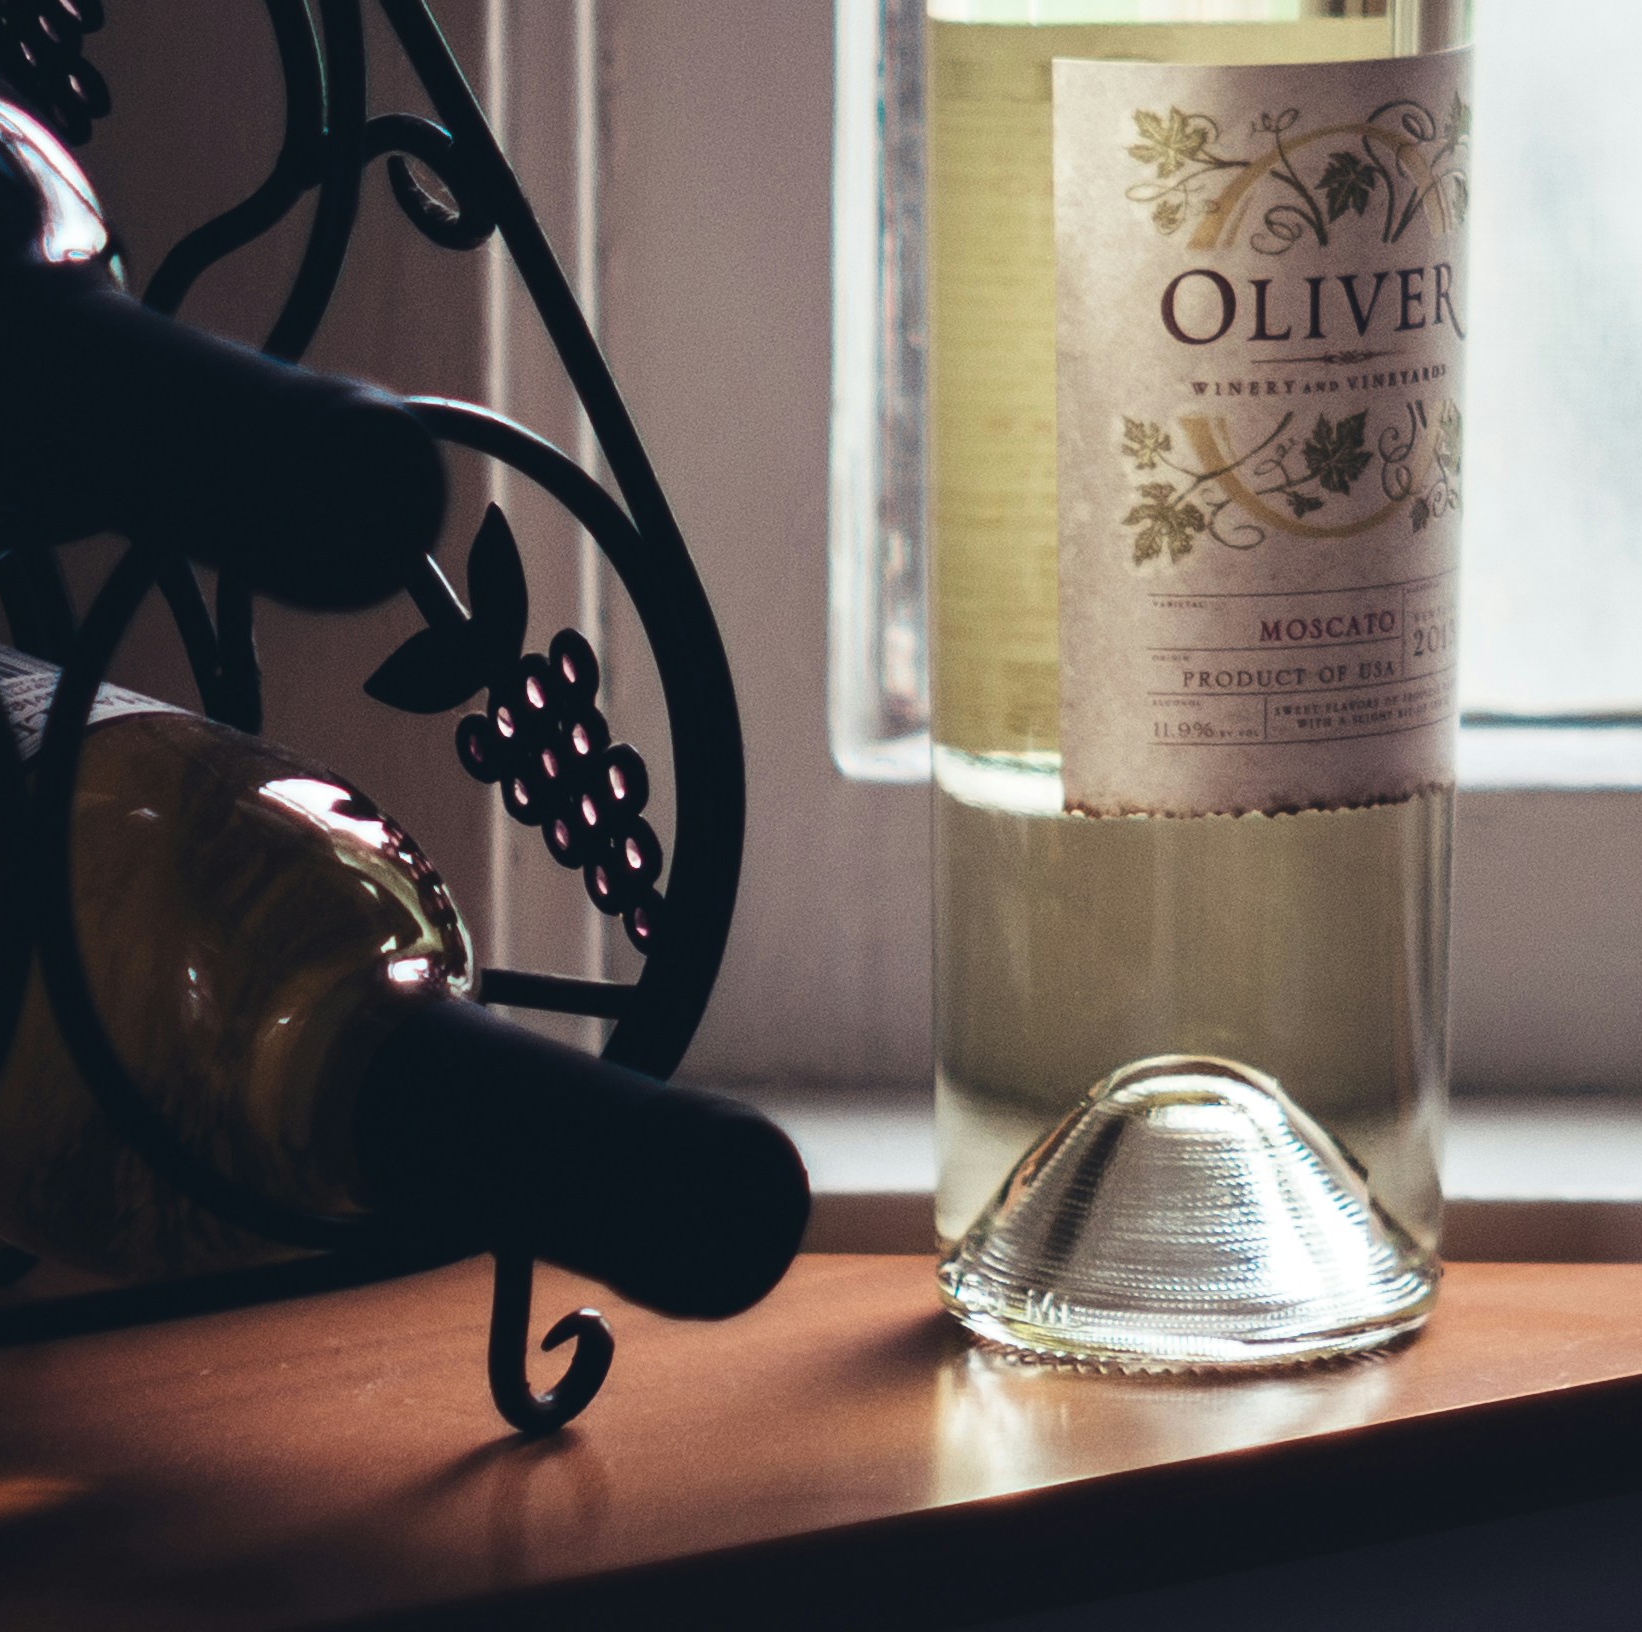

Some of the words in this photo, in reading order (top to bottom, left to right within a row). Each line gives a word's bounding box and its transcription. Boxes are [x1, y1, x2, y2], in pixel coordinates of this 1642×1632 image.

[1161, 262, 1466, 345] OLIVER
[1191, 381, 1296, 397] WINERY
[1303, 380, 1339, 394] AND
[1346, 364, 1446, 391] VINEYARDS
[1260, 610, 1396, 643] MOSCATO
[1183, 668, 1306, 689] PRODUCT
[1318, 666, 1348, 684] OF
[1358, 660, 1396, 680] USA
[1153, 720, 1215, 738] 11.9%
